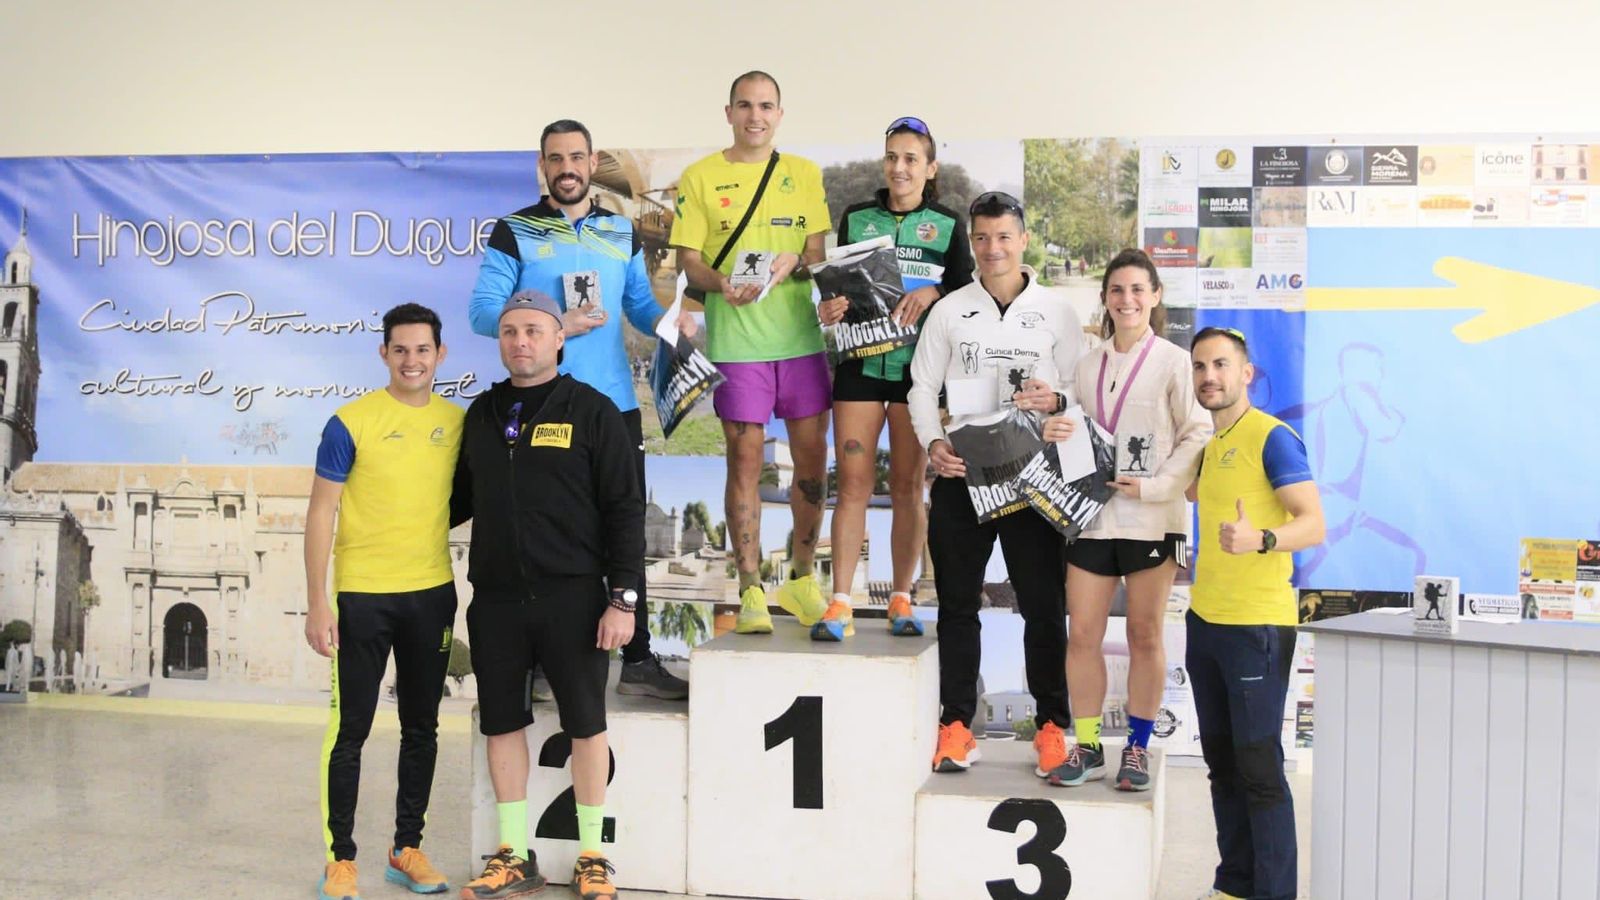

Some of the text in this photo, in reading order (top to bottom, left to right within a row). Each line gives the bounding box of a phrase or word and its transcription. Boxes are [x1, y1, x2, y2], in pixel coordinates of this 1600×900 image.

[1210, 198, 1249, 206] MILAR
[72, 210, 498, 266] Hinojosa del Duque
[896, 246, 922, 260] ISMO
[80, 290, 386, 336] Ciudad Patrimoni
[81, 368, 224, 397] cultural
[234, 385, 266, 412] y
[535, 427, 569, 440] BROOKLYN
[968, 480, 1018, 518] BROO
[764, 696, 824, 809] 1
[535, 731, 616, 843] 2
[985, 798, 1072, 900] 3
